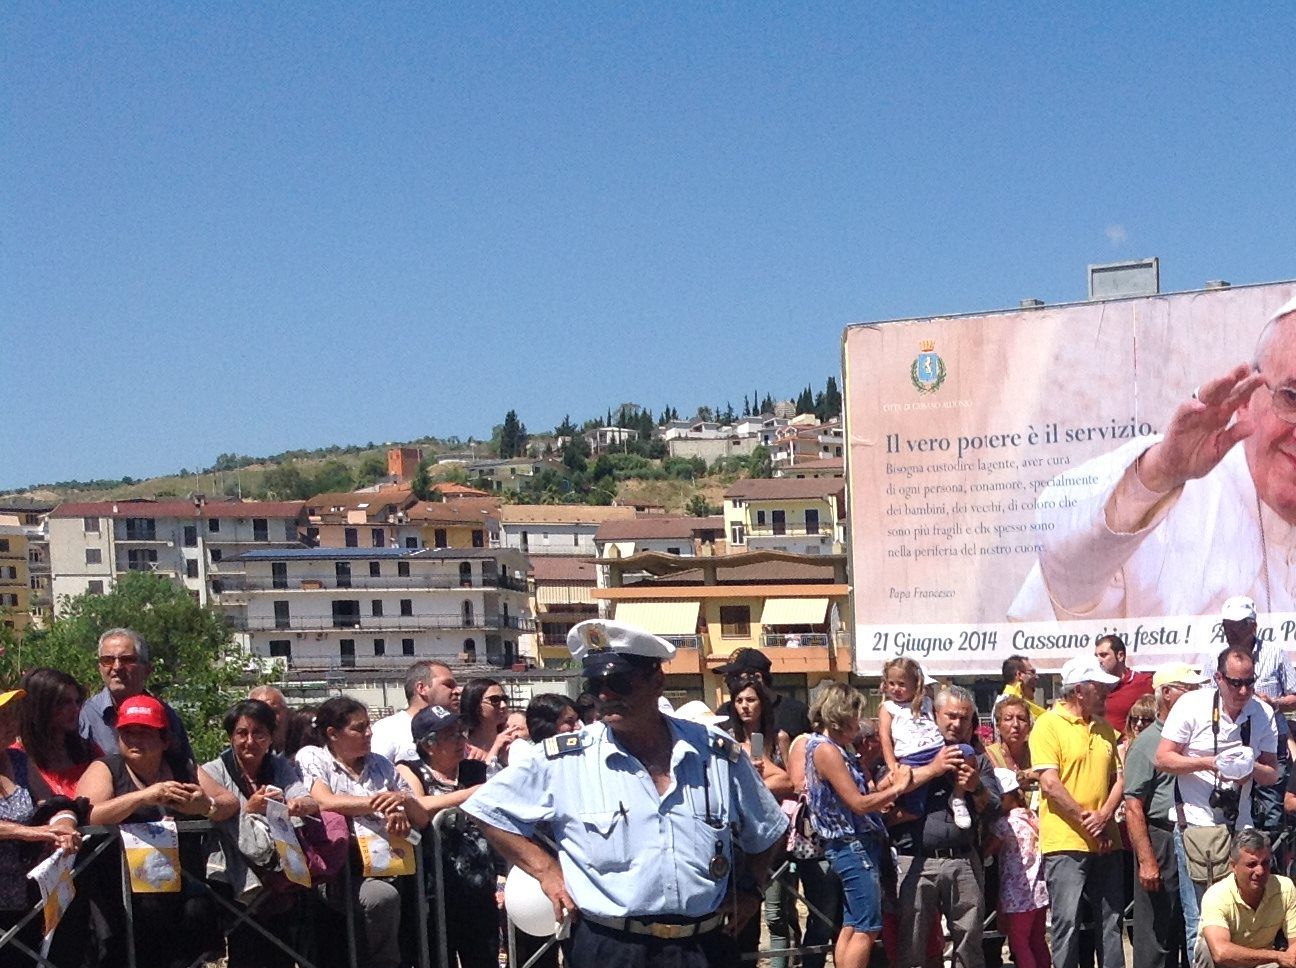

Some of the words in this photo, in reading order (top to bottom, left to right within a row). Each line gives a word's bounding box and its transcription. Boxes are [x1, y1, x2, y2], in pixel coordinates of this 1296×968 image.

[886, 433, 900, 453] Il
[907, 437, 950, 452] vero
[958, 433, 1021, 458] potere
[1028, 425, 1038, 445] è
[1046, 423, 1058, 443] il
[1065, 417, 1157, 442] servizio.
[886, 463, 924, 478] Bisogna
[926, 457, 974, 473] custodire
[1022, 458, 1044, 468] aver
[1047, 456, 1070, 466] cura
[886, 483, 896, 495] di
[899, 485, 920, 499] ogni
[924, 484, 967, 498] persona,
[1030, 474, 1099, 492] specialmente
[886, 503, 901, 515] dei
[905, 502, 949, 516] bambini,
[952, 501, 967, 514] dei
[971, 501, 1005, 514] vecchi,
[1008, 498, 1018, 511] di
[1021, 498, 1055, 511] coloro
[1059, 495, 1077, 508] che
[887, 529, 911, 537] sono
[914, 526, 930, 540] più
[933, 522, 962, 540] fragili
[965, 526, 972, 534] e
[994, 525, 1027, 538] spesso
[1030, 522, 1055, 531] sono
[887, 544, 911, 558] nella
[914, 544, 958, 560] periferia
[961, 543, 976, 556] del
[889, 587, 911, 603] Papa
[914, 586, 956, 598] Francesco
[872, 631, 889, 651] 21
[894, 631, 953, 657] Giugno
[958, 630, 997, 651] 2014
[1012, 629, 1091, 650] Cassano
[1133, 624, 1180, 652] festa
[1210, 622, 1277, 643] Ava
